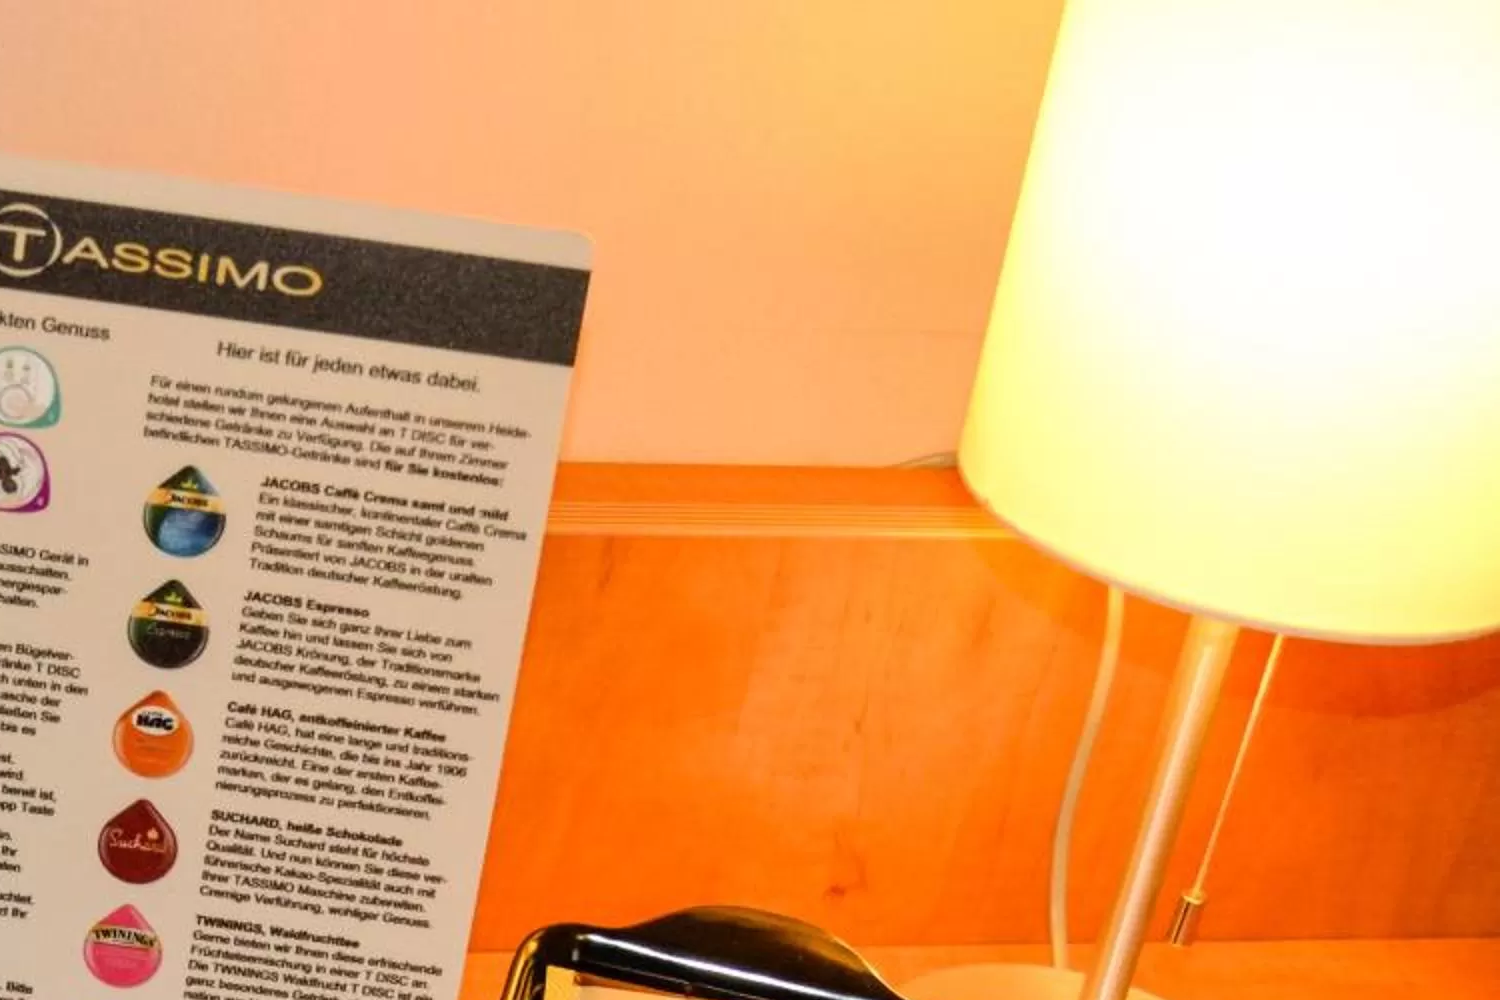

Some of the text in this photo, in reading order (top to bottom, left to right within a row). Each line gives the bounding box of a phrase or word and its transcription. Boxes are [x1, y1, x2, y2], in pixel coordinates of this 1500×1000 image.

[40, 316, 110, 341] Genuss
[216, 340, 480, 392] Hier ist für jeden etwas dabei.
[243, 590, 370, 618] JACOBS Espresso
